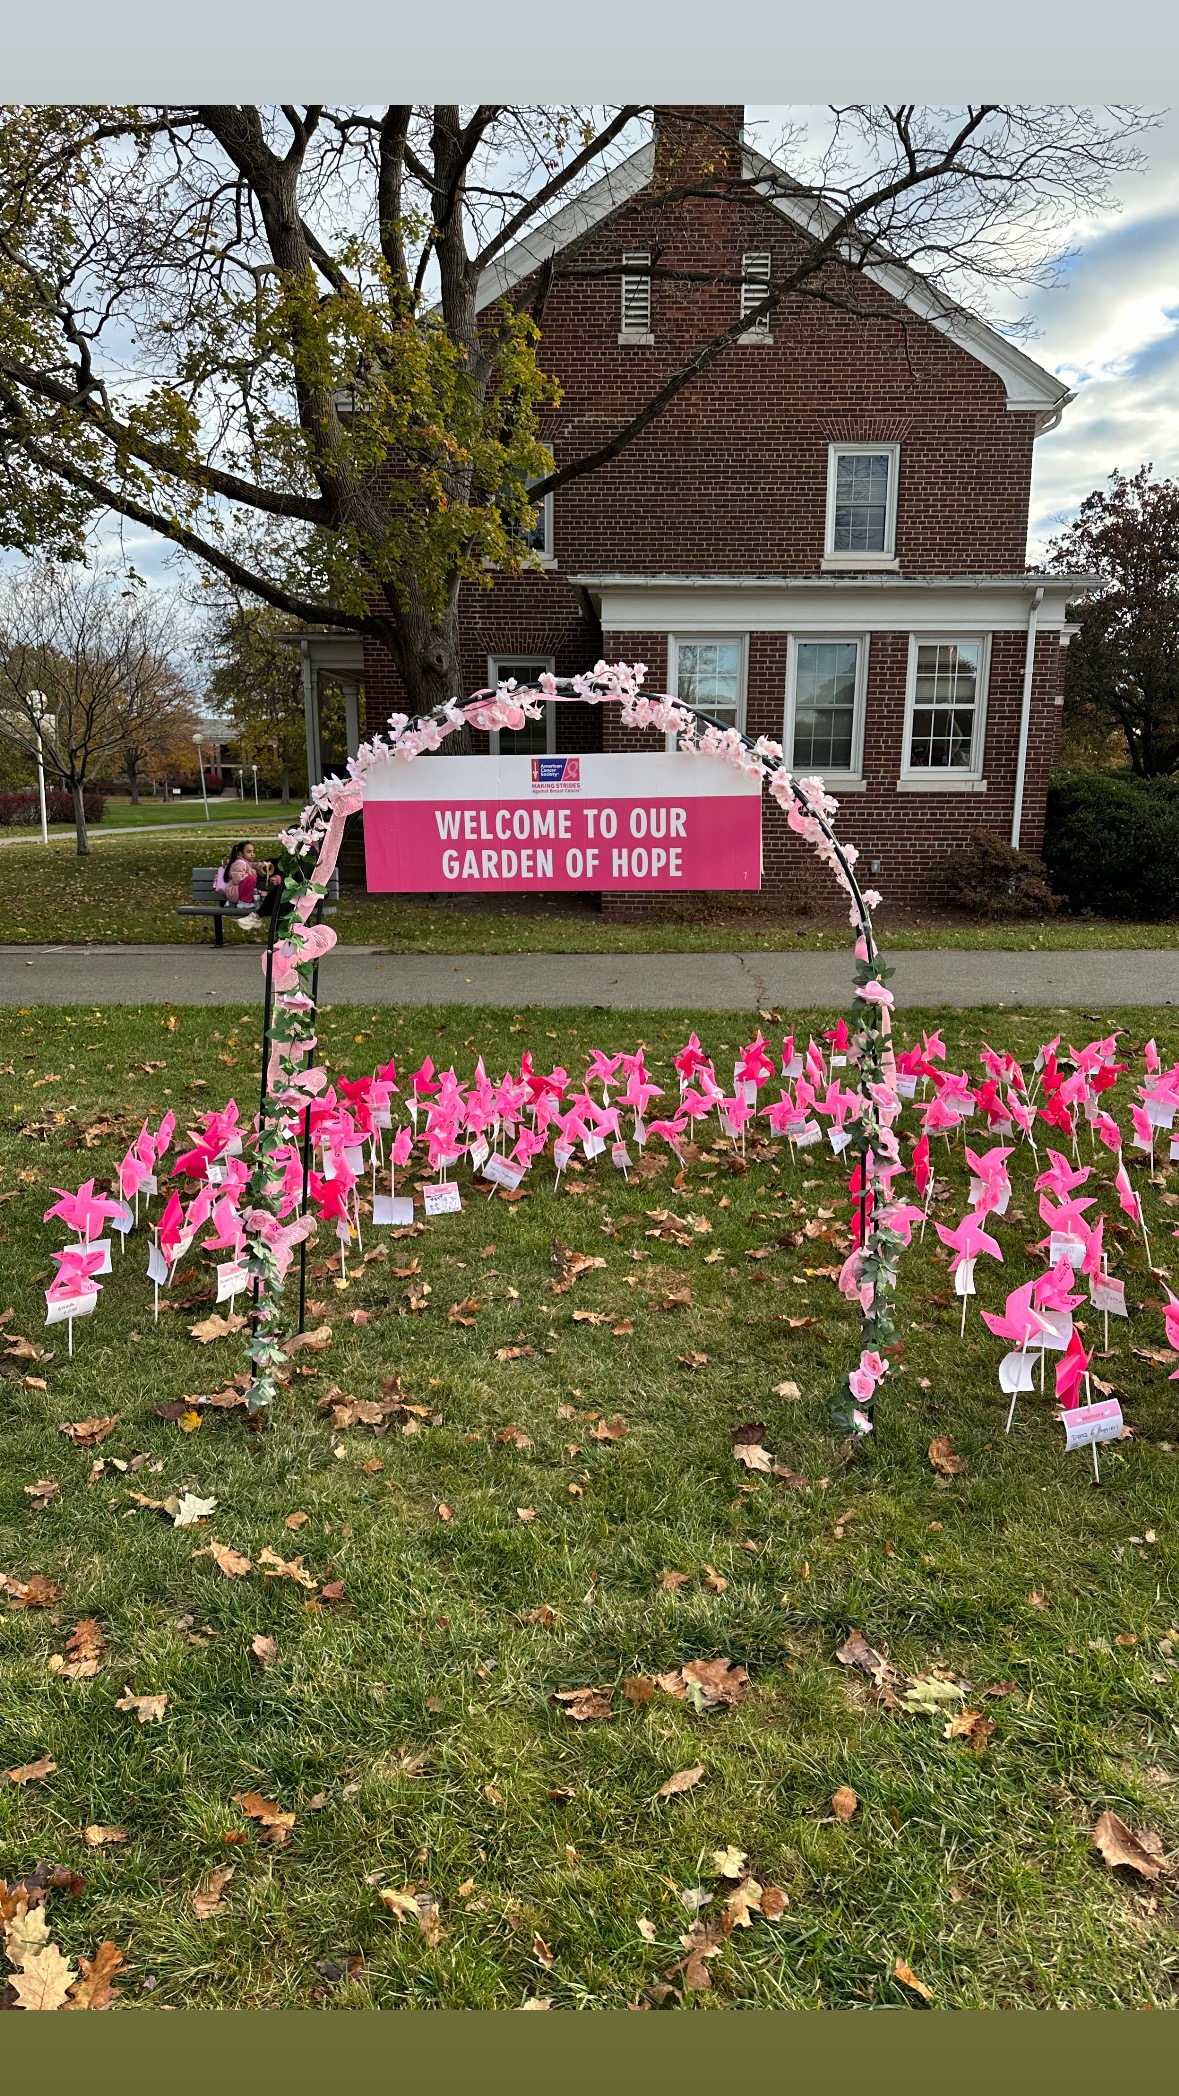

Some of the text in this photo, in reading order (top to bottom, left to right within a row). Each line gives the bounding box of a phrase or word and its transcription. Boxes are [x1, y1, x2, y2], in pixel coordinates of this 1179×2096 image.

[435, 807, 687, 840] WELCOME TO OUR
[441, 846, 683, 879] GARDEN OF HOPE
[1083, 1412, 1104, 1420] Memory
